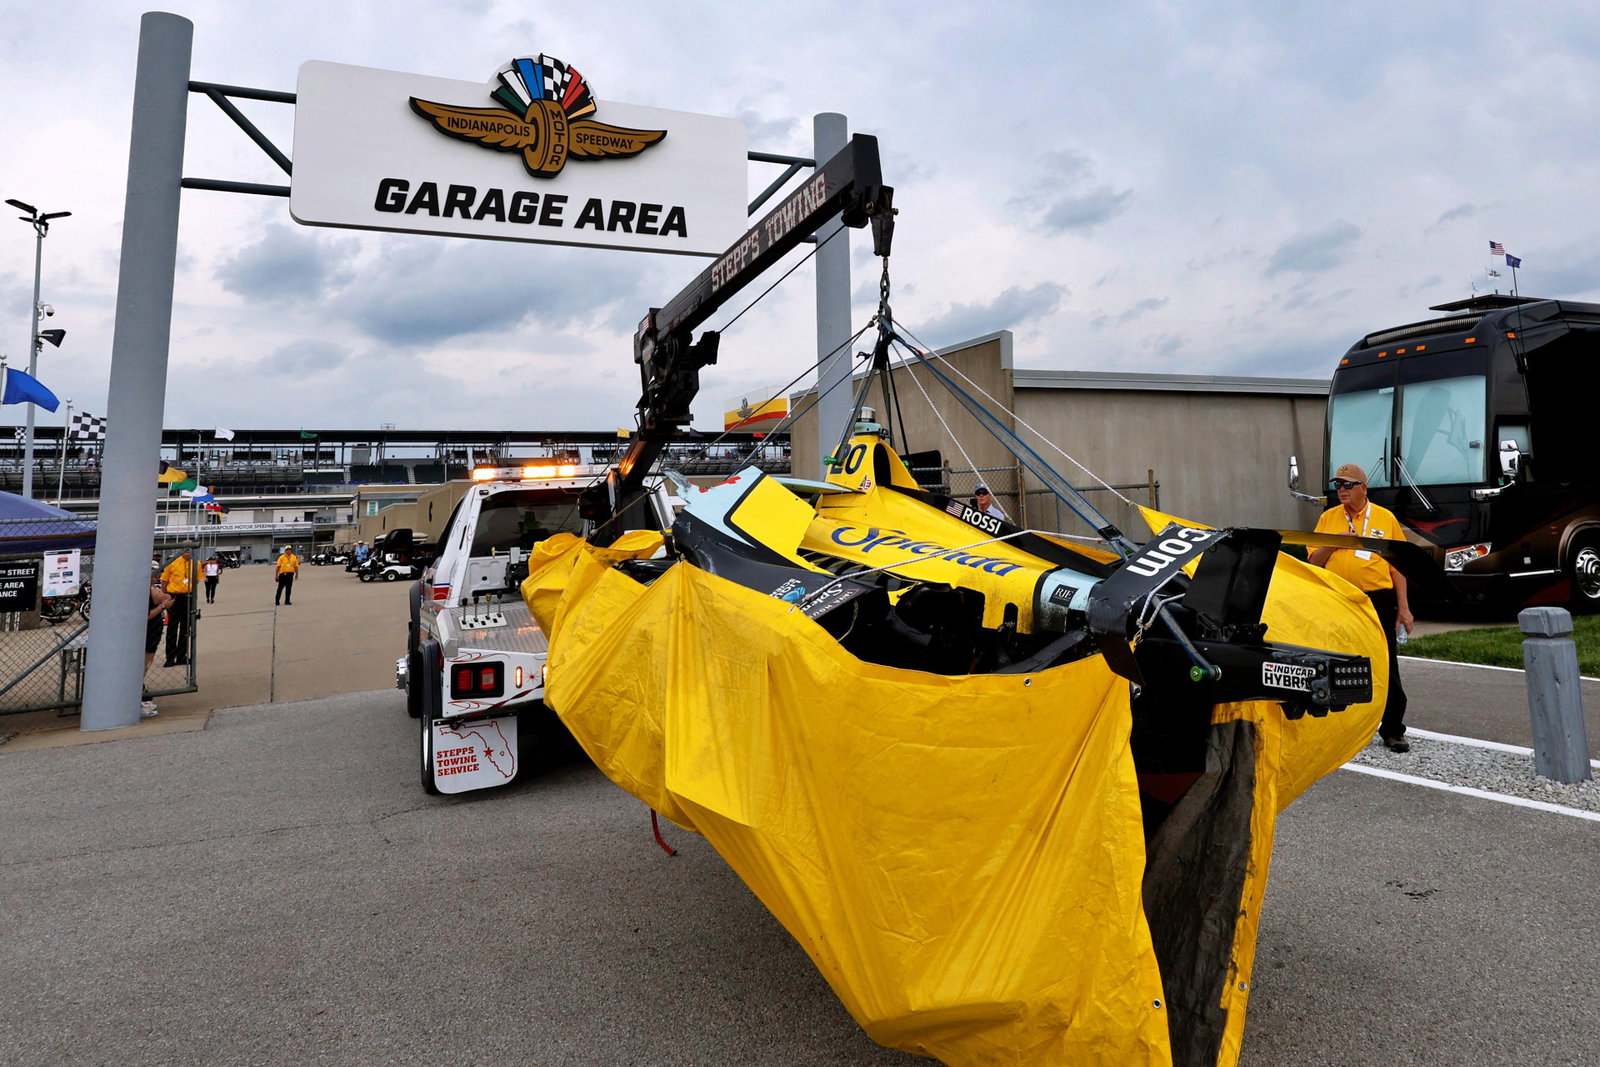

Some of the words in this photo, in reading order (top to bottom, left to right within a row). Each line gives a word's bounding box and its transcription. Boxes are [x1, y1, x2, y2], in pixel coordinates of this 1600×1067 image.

[447, 116, 530, 137] INDIANAPOLIS
[549, 109, 565, 166] MOTOR
[575, 132, 634, 150] SPEEDWAY
[374, 177, 568, 227] GARAGE
[574, 197, 688, 239] AREA
[711, 228, 760, 293] STEPP'S
[765, 172, 827, 247] TOWING
[962, 507, 1002, 535] ROSSI
[1126, 527, 1212, 577] com
[7, 568, 36, 576] STREET
[4, 581, 25, 589] AREA
[774, 579, 801, 599] LIQU
[800, 583, 843, 612] Splen
[809, 604, 833, 618] HOU
[436, 746, 474, 759] STEPPS
[436, 755, 477, 767] TOWING
[437, 763, 480, 776] SERVICE
